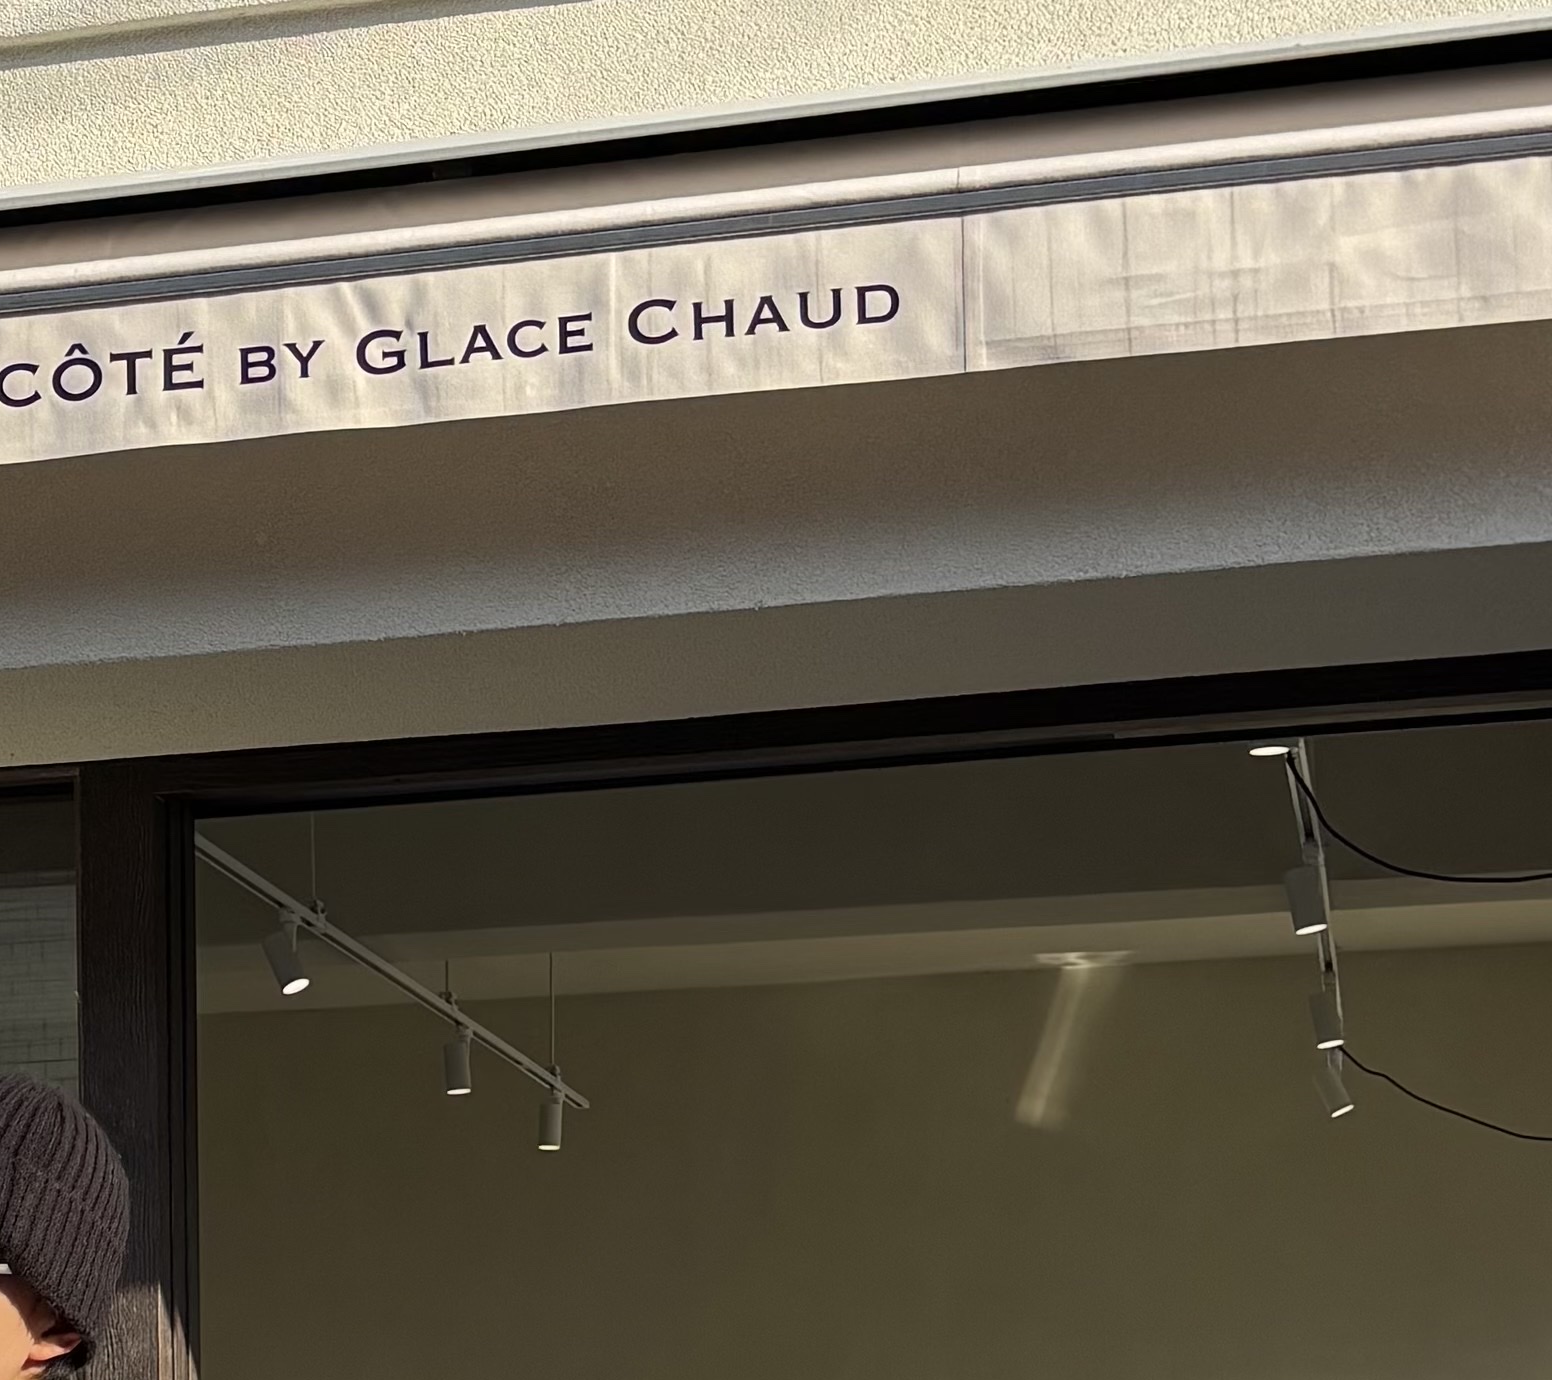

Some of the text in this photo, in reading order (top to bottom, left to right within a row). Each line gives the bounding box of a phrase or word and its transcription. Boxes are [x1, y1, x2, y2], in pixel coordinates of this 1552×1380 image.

[238, 339, 326, 386] BY
[356, 312, 595, 376] GLACE
[627, 284, 901, 346] CHAUD
